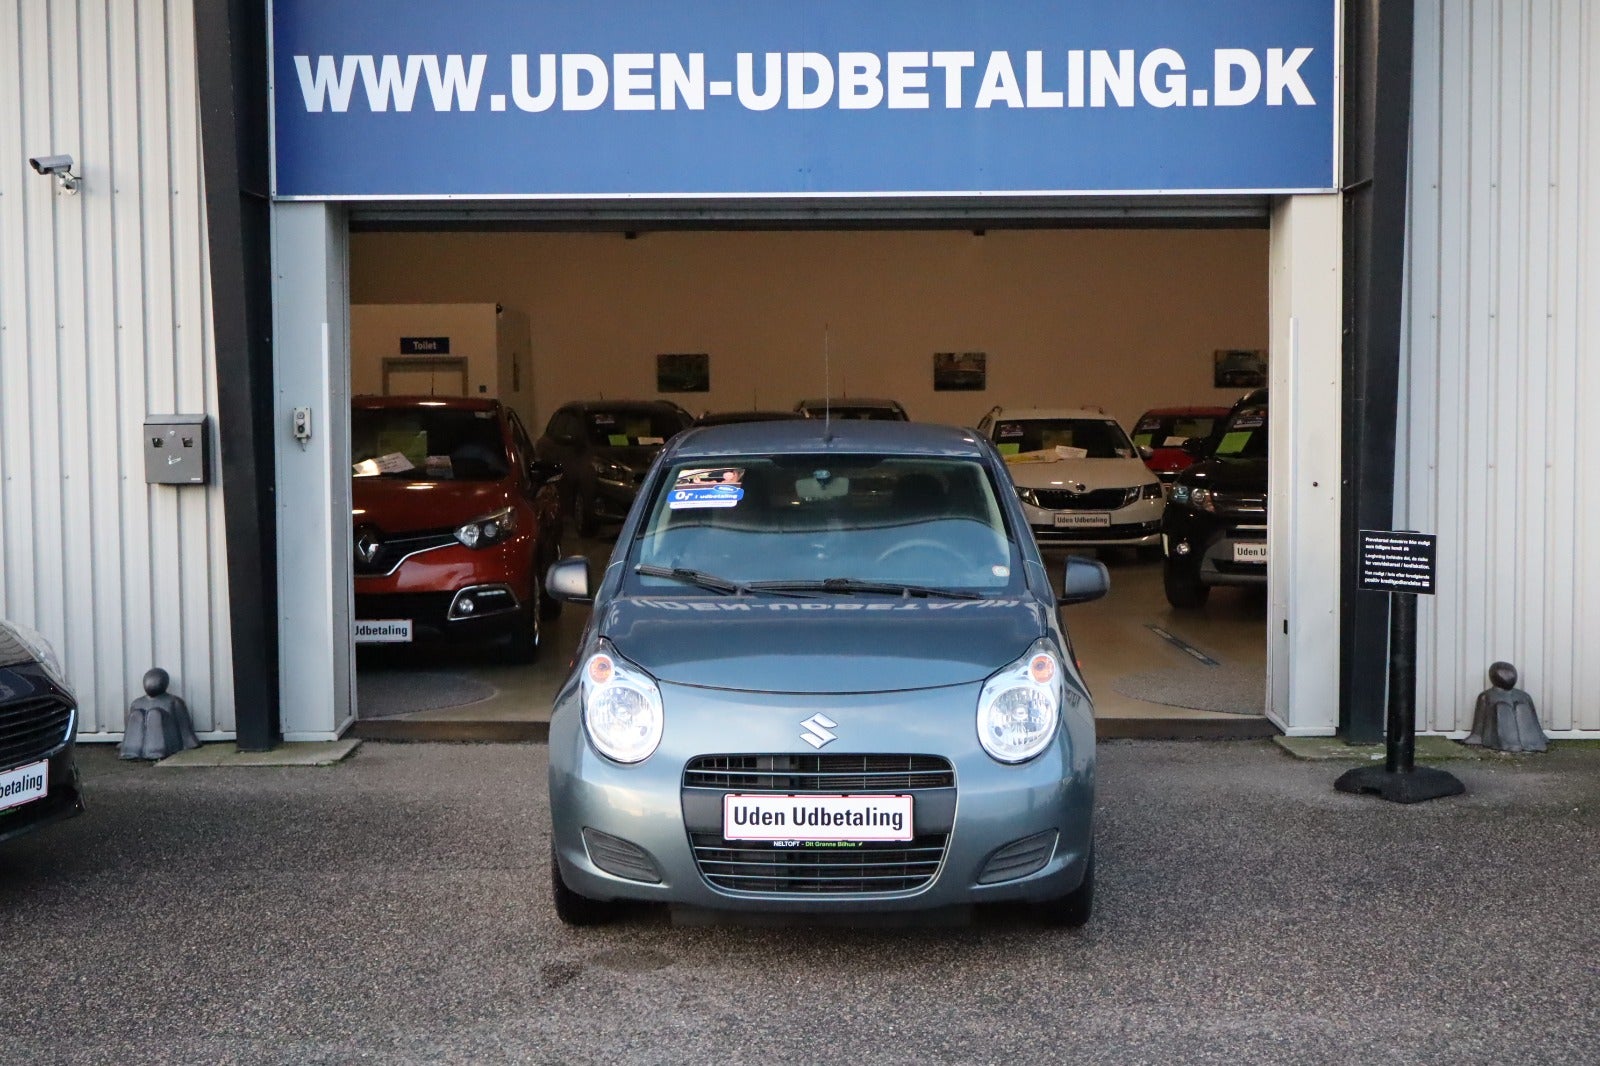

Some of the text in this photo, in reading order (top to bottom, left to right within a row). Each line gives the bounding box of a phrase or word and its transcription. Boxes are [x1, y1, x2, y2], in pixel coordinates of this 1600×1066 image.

[294, 48, 1316, 113] WWW.UDEN-UDBETALING.DK
[413, 341, 437, 350] Toilet
[1237, 547, 1258, 556] Uden
[734, 806, 903, 831] Uden Udbetaling
